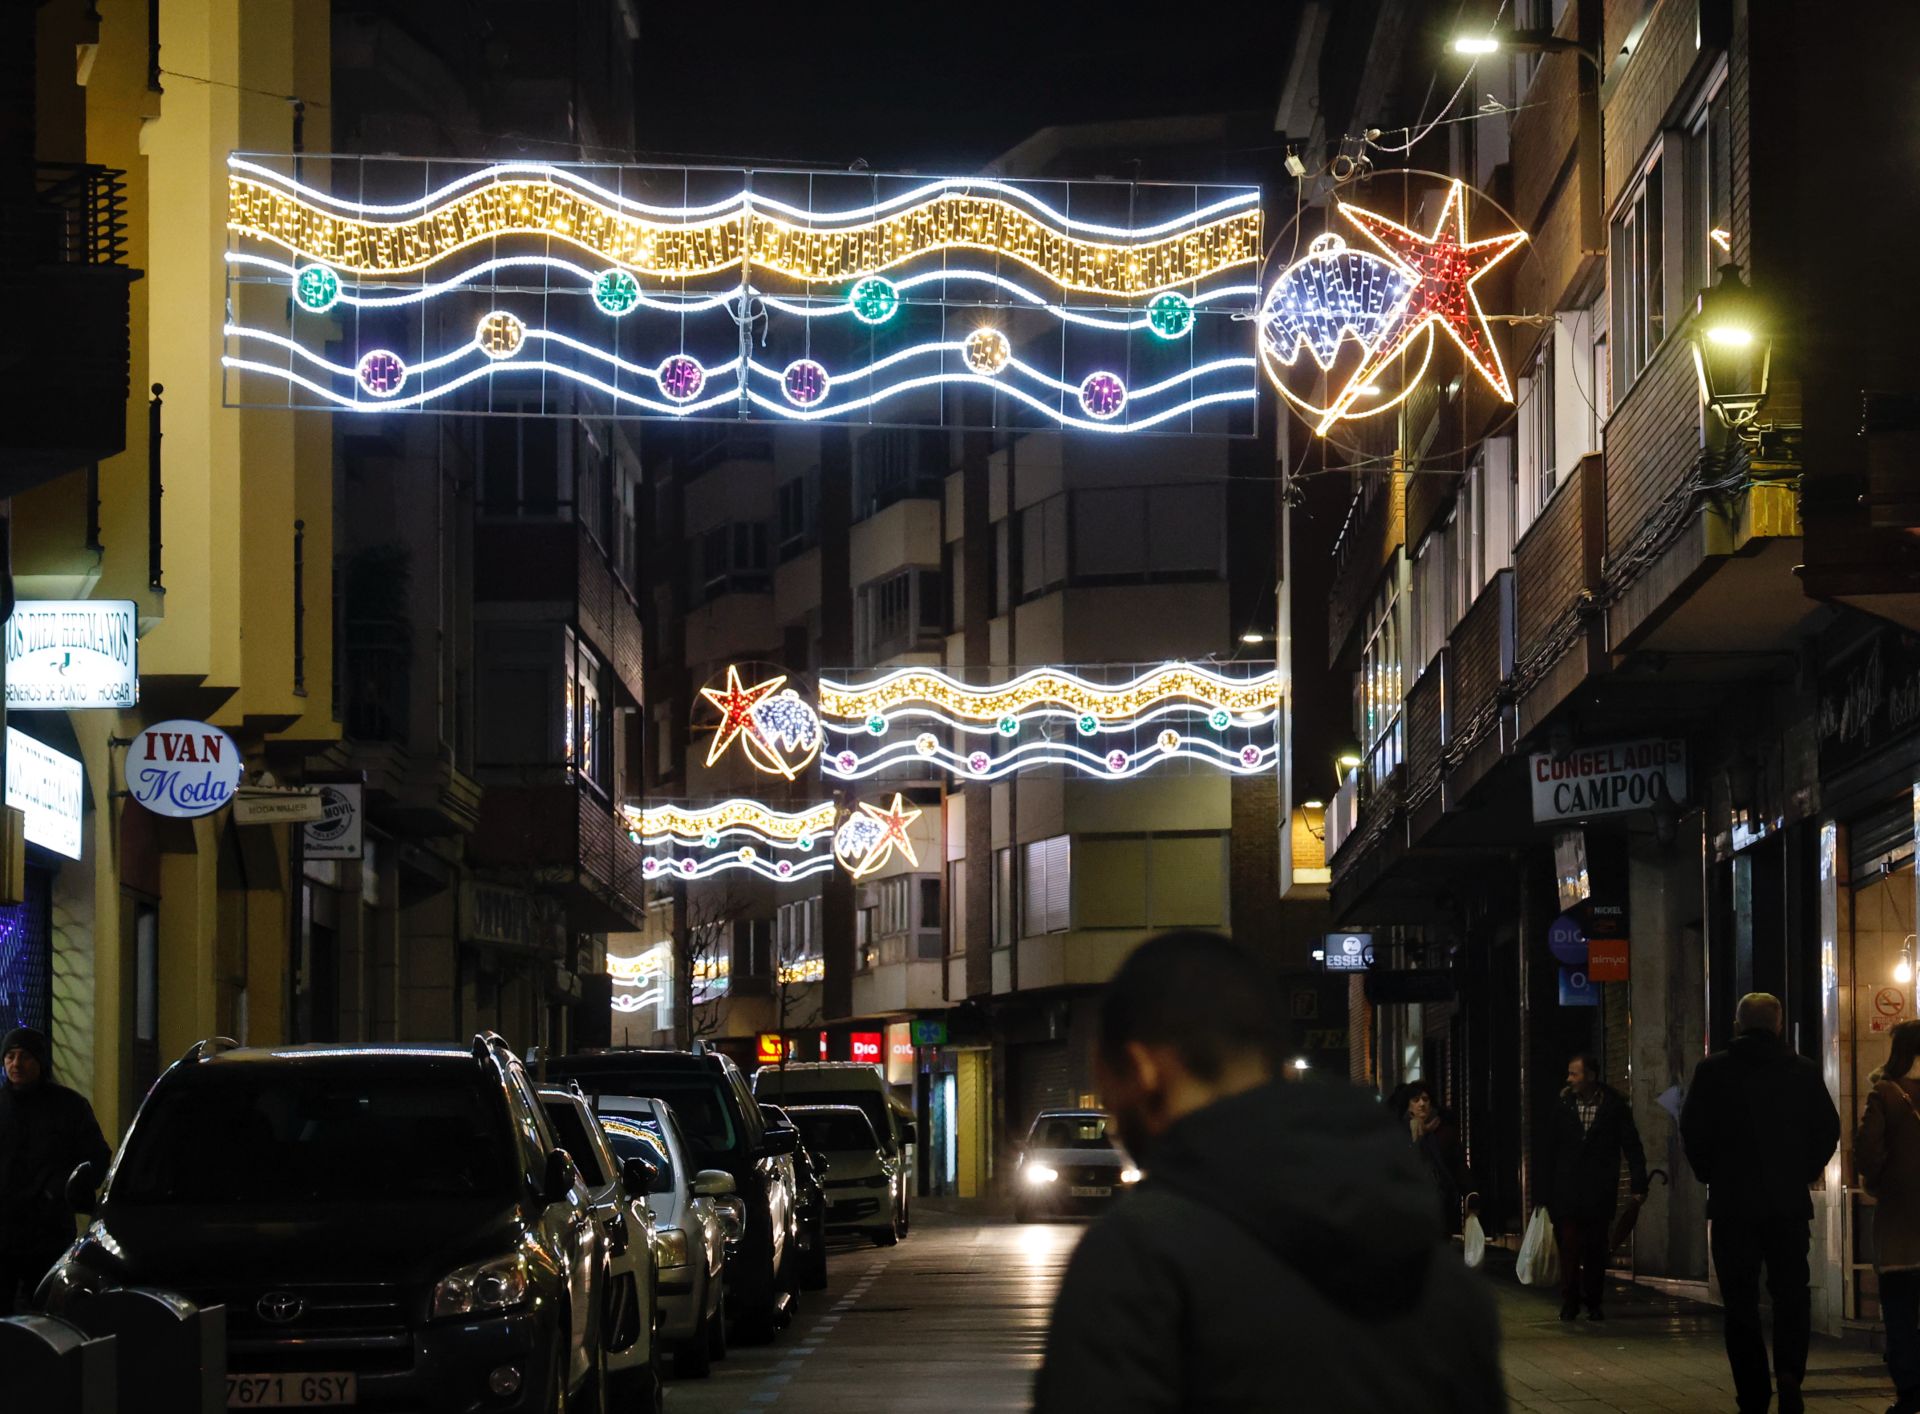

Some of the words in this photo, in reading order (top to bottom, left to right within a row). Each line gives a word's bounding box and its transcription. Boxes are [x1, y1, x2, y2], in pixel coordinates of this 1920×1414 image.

[29, 612, 56, 653] DIEZ
[61, 612, 129, 667] HERMANOS
[46, 683, 56, 702] DE
[60, 683, 88, 702] PUNTO
[97, 682, 131, 702] HOGAR
[143, 732, 224, 763] IVAN
[1536, 742, 1682, 782] CONGELADOS
[136, 768, 230, 809] Moda
[1553, 771, 1666, 814] CAMPOO
[248, 805, 275, 816] MODA
[324, 803, 356, 818] MOVIL
[1593, 906, 1623, 916] NICKEL
[1592, 955, 1627, 967] simyo
[225, 1379, 284, 1404] 7671
[301, 1377, 348, 1402] GSY
